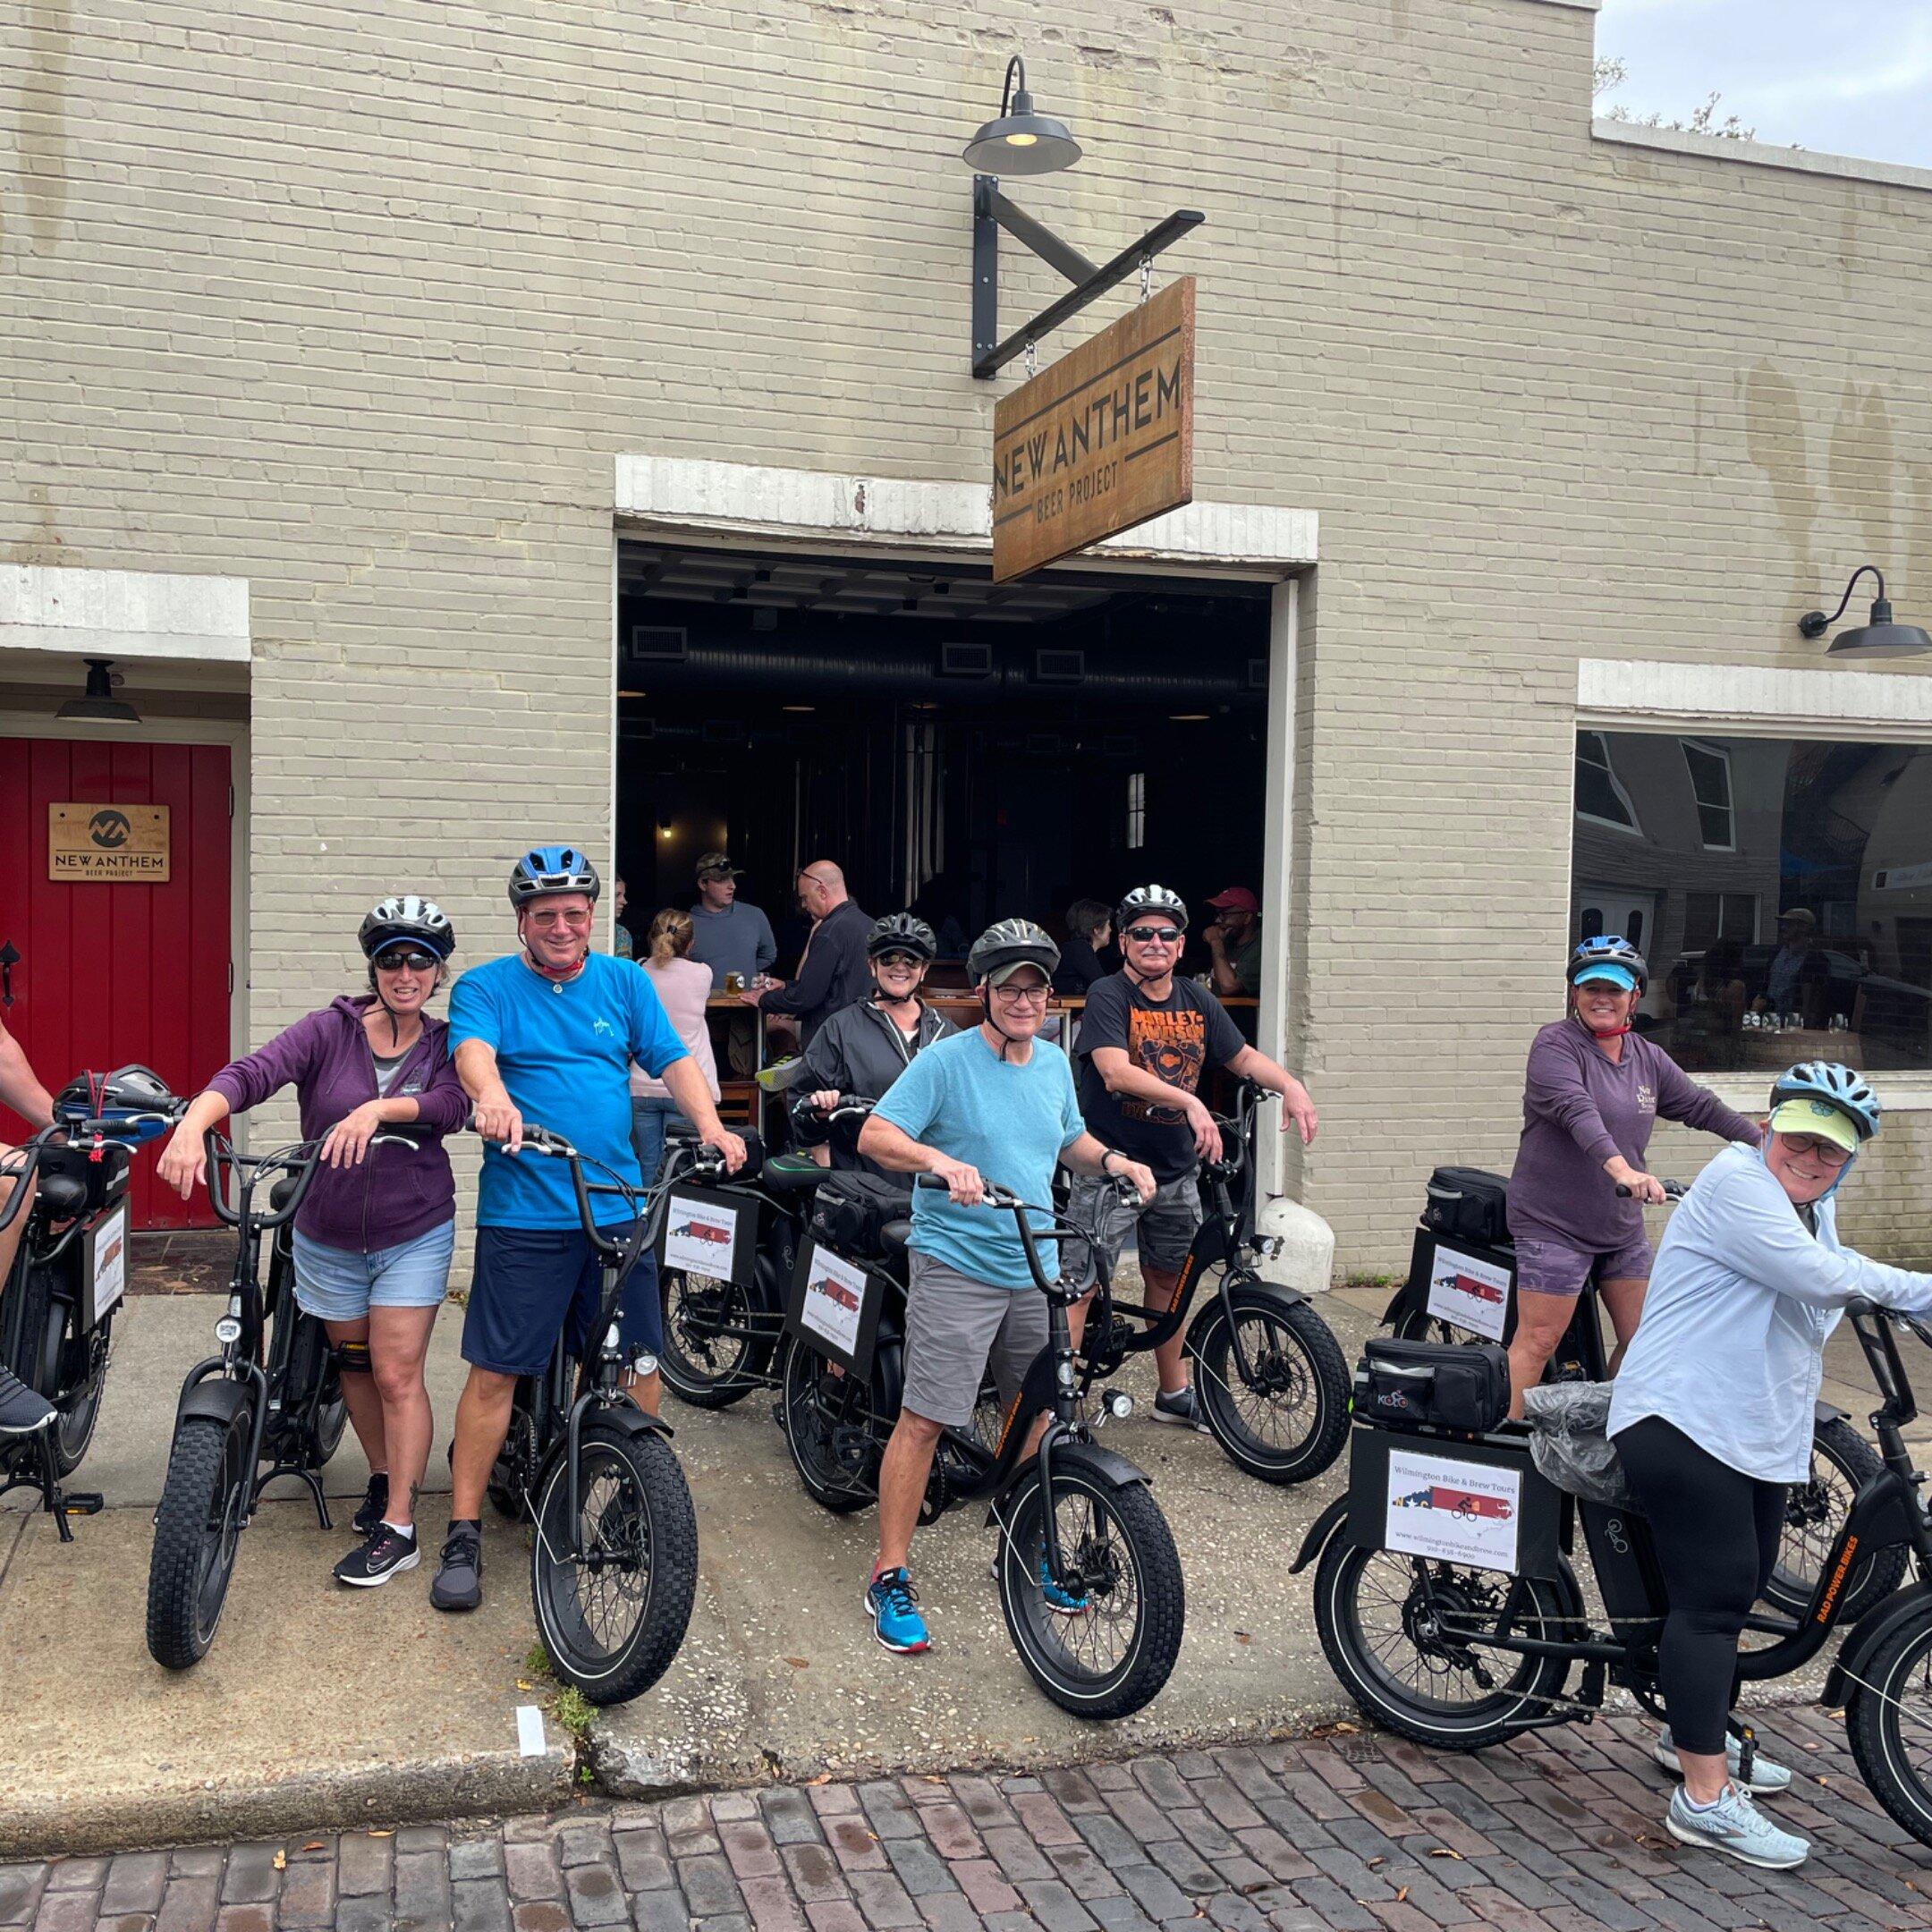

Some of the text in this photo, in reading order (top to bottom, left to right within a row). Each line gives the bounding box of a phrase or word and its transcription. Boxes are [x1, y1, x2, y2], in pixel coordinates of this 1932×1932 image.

[994, 357, 1181, 504] NEW ANTHEM
[1038, 462, 1117, 524] BEER PROJECT
[55, 855, 163, 868] NEW ANTHEM
[1394, 1466, 1515, 1494] Wilmington Bike & Brew Tours
[1817, 1535, 1858, 1623] RAD POWER BIKES
